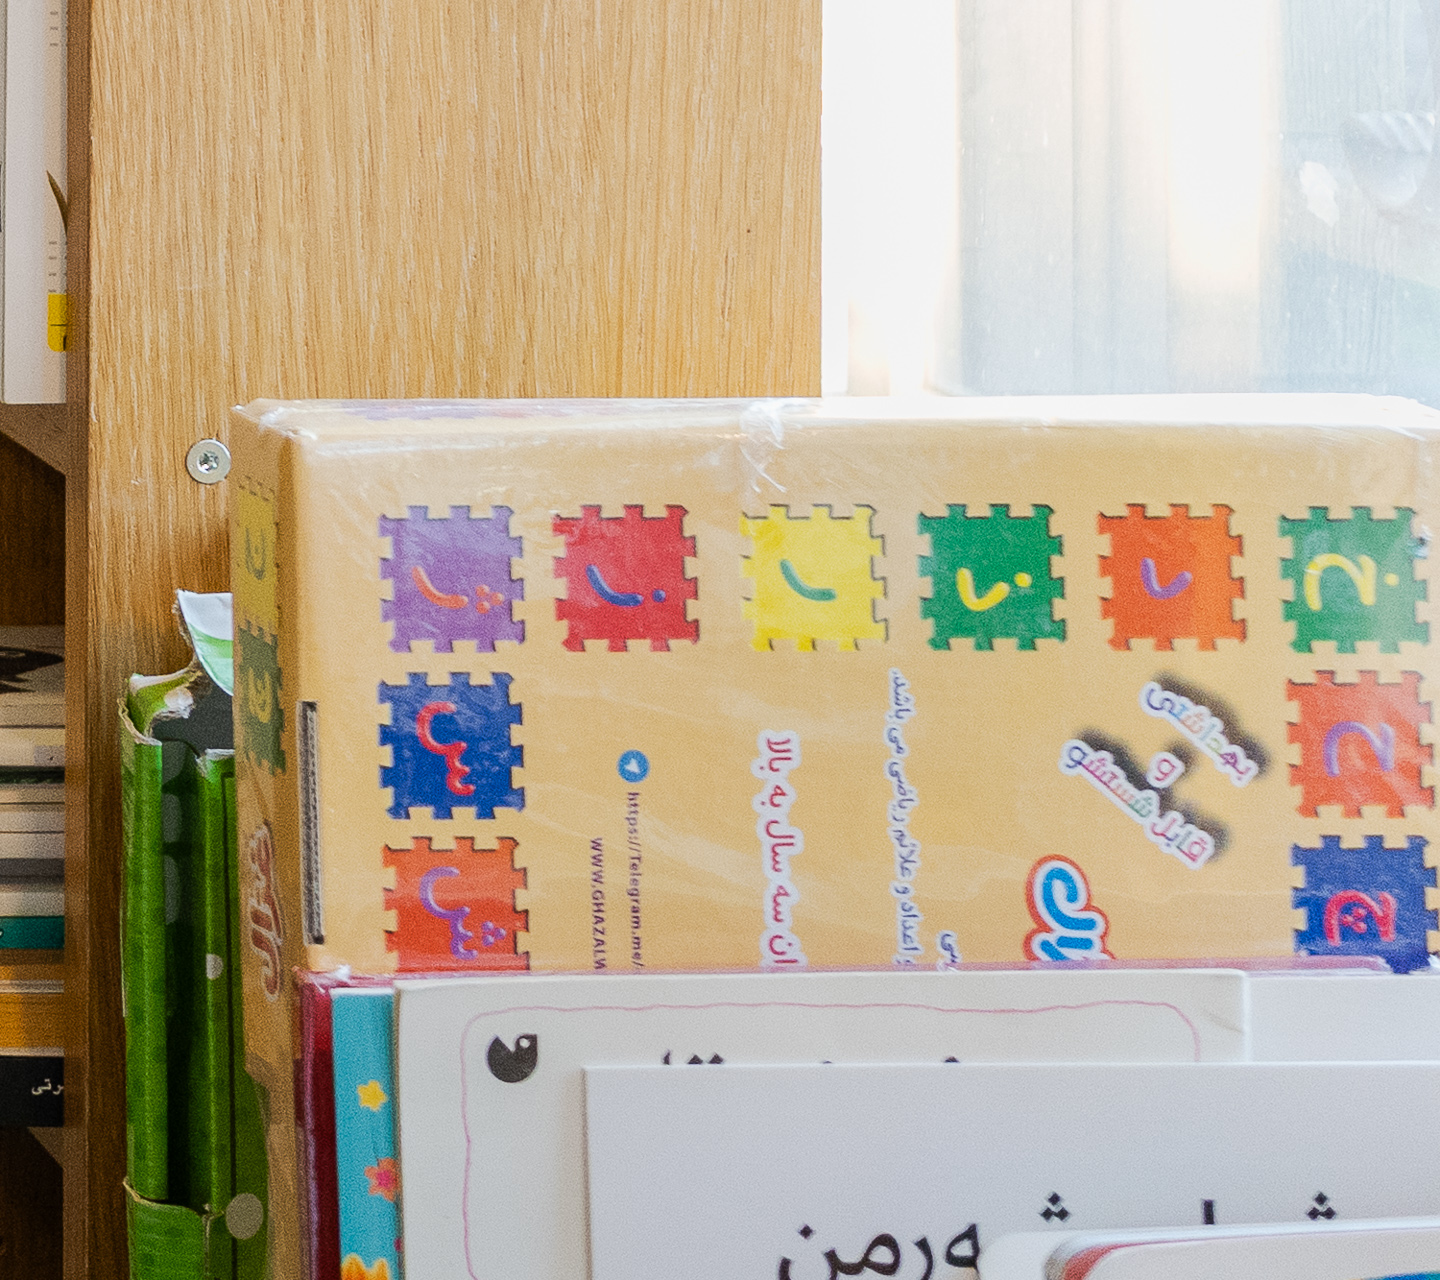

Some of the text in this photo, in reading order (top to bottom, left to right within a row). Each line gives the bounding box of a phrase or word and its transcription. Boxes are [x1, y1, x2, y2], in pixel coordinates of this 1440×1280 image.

[586, 564, 666, 607] ز
[780, 559, 837, 601] ر
[957, 568, 1032, 611] ذ
[1140, 557, 1192, 600] د
[1304, 553, 1399, 611] خ
[416, 701, 475, 796] س
[760, 738, 793, 772] بالا
[1323, 721, 1395, 778] ح
[761, 784, 787, 809] به
[766, 821, 796, 873] سال
[773, 884, 791, 924] سه
